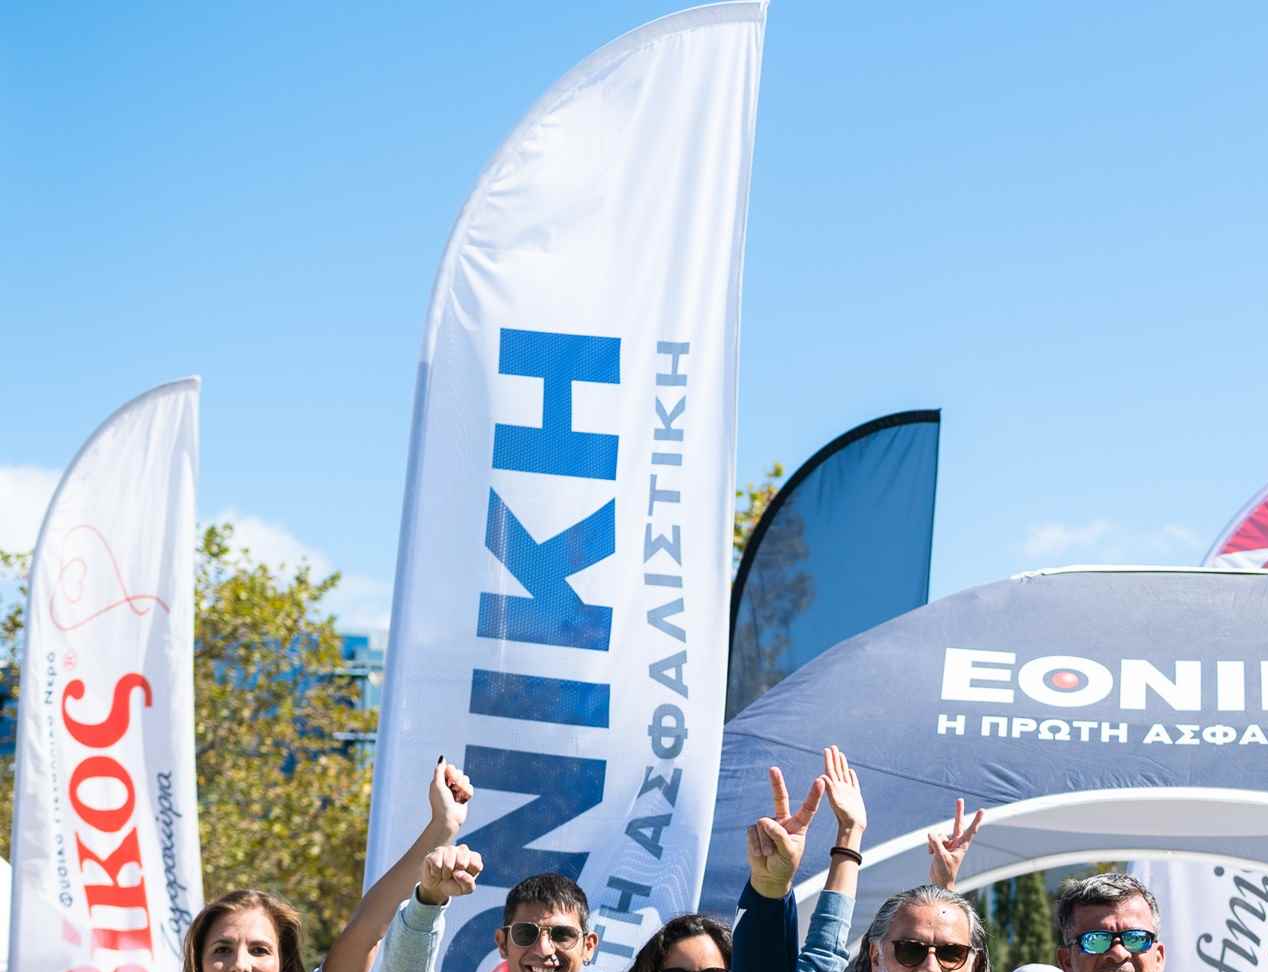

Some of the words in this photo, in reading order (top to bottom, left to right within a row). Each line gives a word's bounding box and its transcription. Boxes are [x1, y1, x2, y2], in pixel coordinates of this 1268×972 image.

[625, 340, 691, 860] ΑΣΦΑΛΙΣΤΙΚΗ
[936, 713, 966, 736] Η
[980, 715, 1128, 743] ΠΡΩΤΗ
